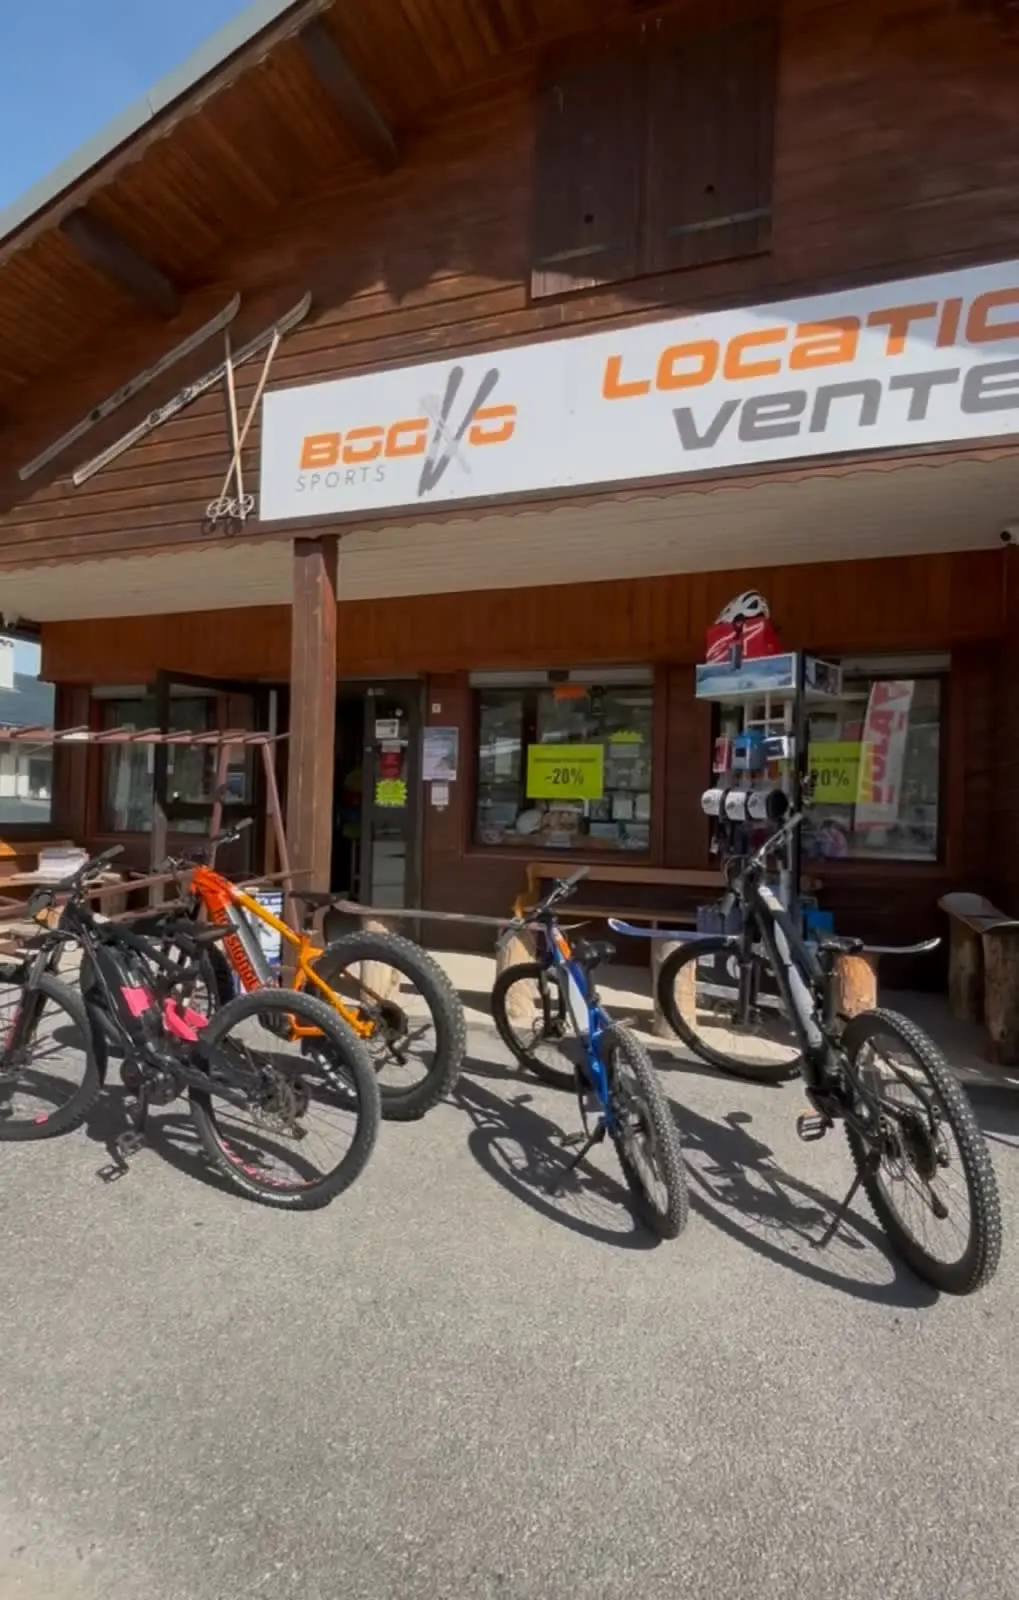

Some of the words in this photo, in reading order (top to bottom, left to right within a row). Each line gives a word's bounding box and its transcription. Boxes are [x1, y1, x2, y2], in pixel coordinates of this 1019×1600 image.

[296, 464, 386, 492] SPORTS
[544, 767, 584, 786] -20%
[213, 907, 260, 987] ROSIGNOL
